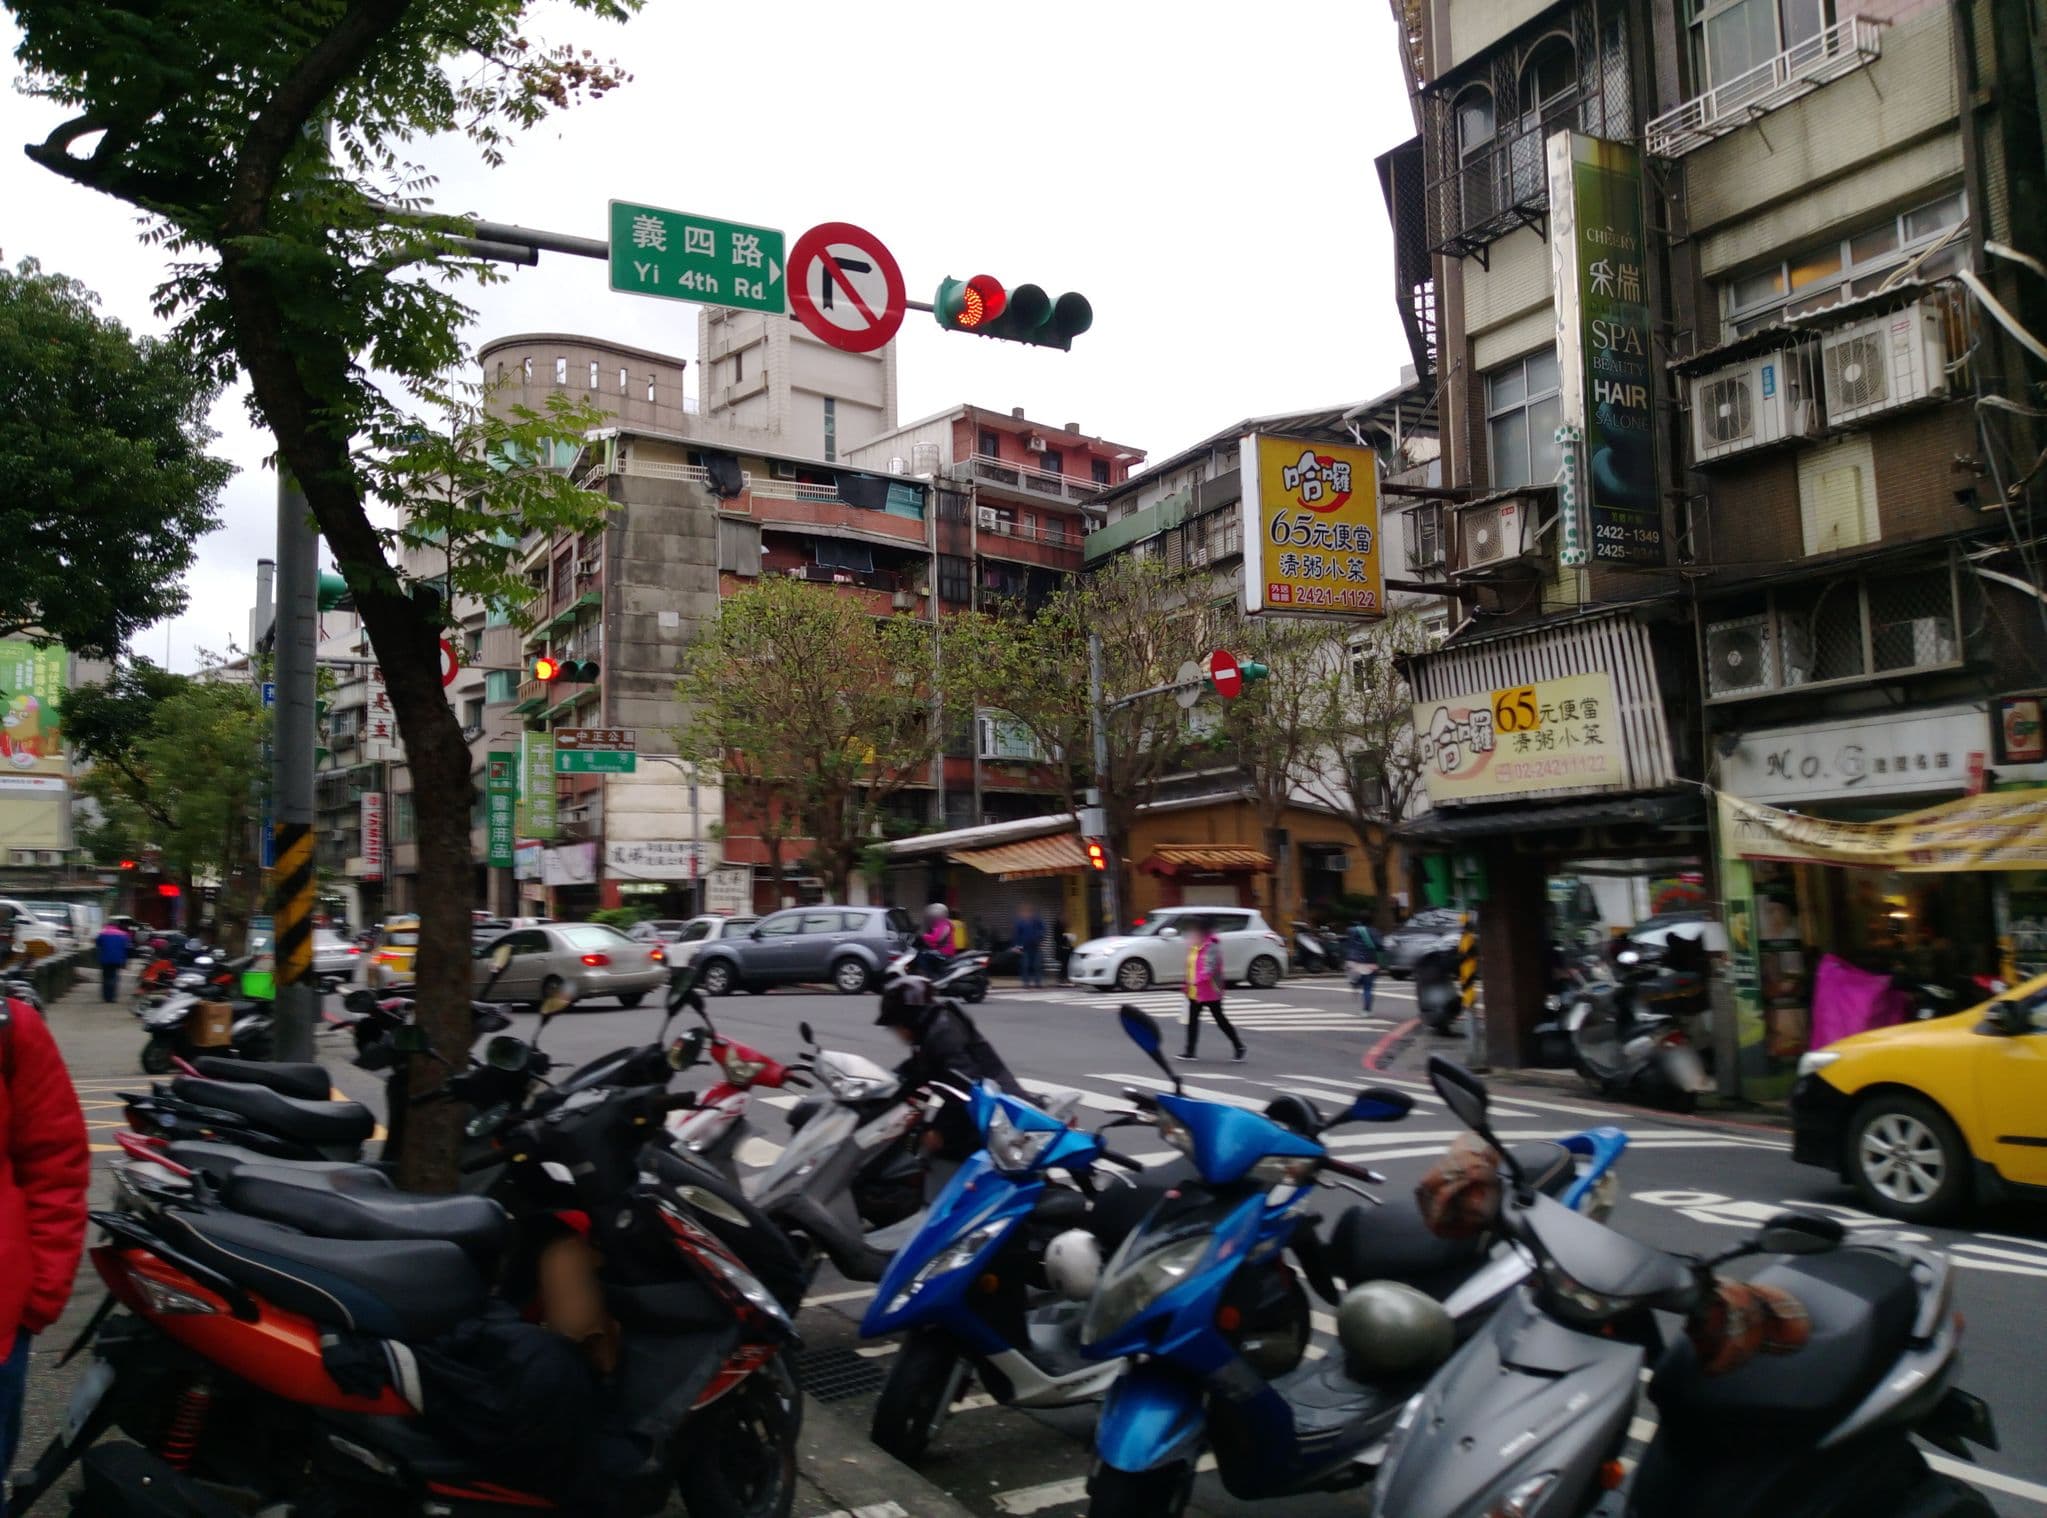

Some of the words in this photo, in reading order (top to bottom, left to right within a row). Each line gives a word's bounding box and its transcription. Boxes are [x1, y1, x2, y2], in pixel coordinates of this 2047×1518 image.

[632, 214, 765, 269] 義四路
[632, 260, 661, 285] Yi
[678, 269, 719, 294] 4th
[734, 278, 767, 301] Rd.
[1591, 319, 1644, 356] SPA
[1593, 356, 1646, 377] BEAUTY
[1593, 378, 1647, 410] HAIR
[1282, 450, 1352, 501] 哈囉
[1271, 509, 1372, 553] 65元便當
[1596, 524, 1660, 544] 2422-1349
[1279, 554, 1368, 581] 清粥小菜
[1296, 586, 1376, 608] 2421-1122
[1495, 690, 1599, 733] 65元便當
[1512, 724, 1605, 754] 清粥小菜
[367, 811, 383, 866] YAMAHA
